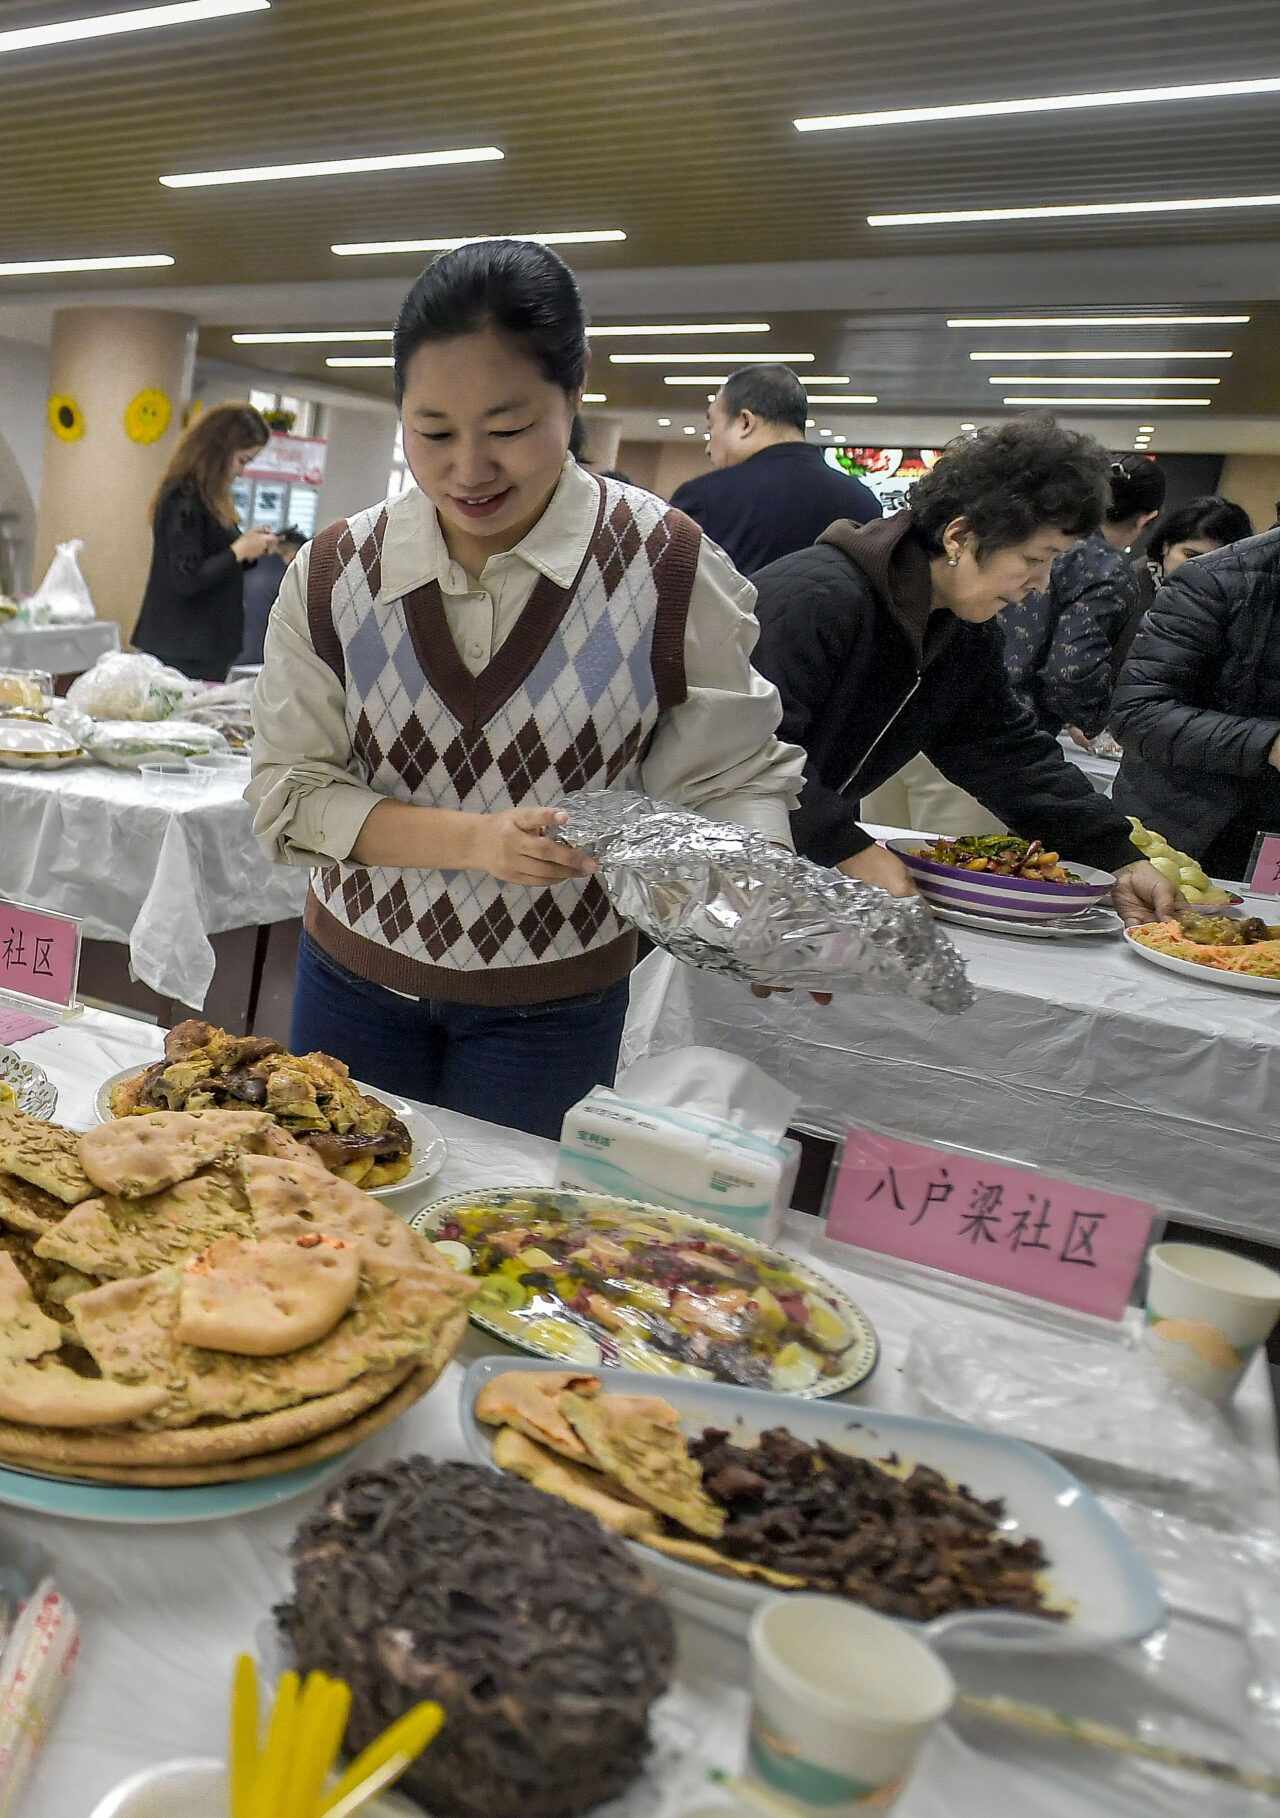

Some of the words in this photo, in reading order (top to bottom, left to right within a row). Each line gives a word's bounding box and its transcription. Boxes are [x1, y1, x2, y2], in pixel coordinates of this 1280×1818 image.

[865, 1166, 1107, 1268] 八户梁社区
